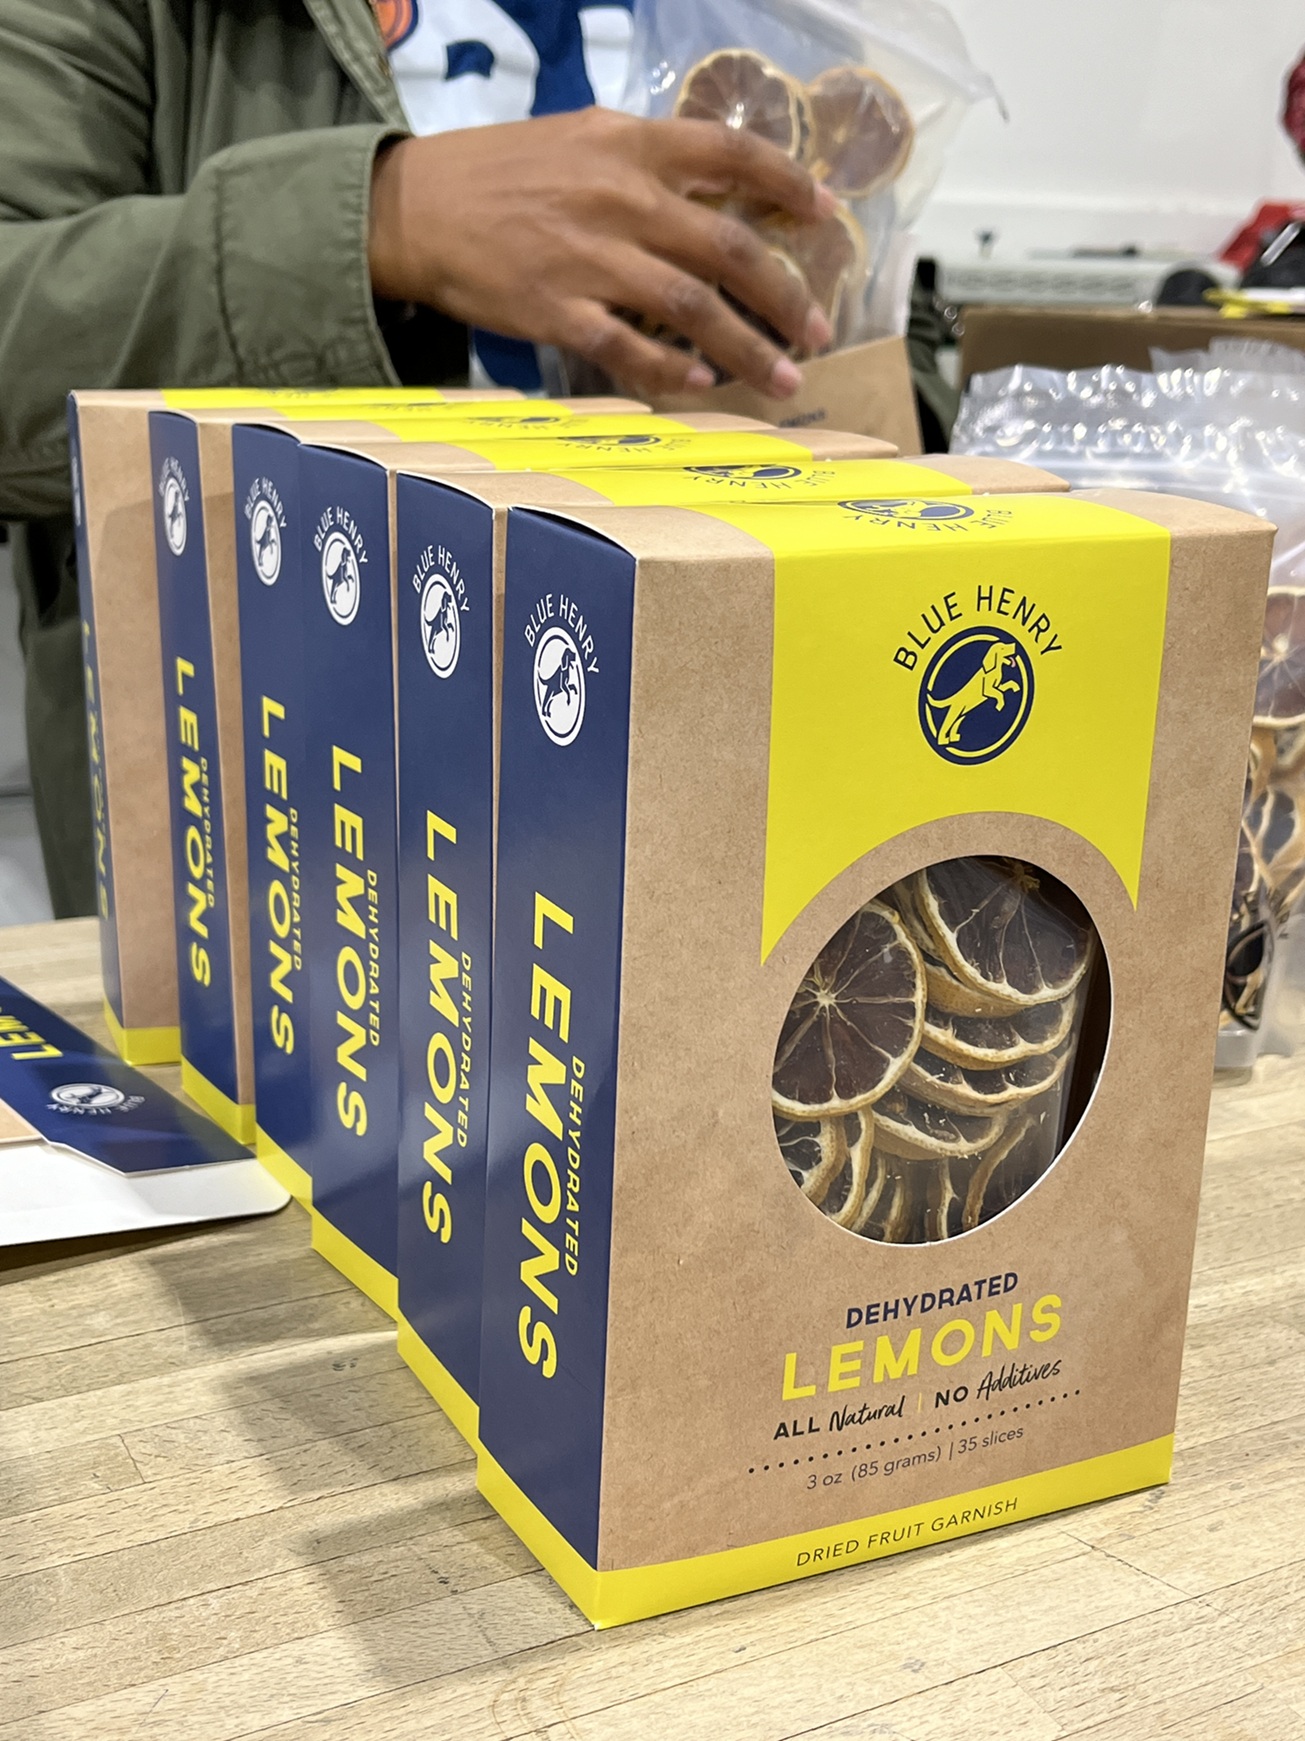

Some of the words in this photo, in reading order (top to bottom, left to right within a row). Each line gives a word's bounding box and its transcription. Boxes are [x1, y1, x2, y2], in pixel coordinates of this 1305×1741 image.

[261, 476, 287, 528] HENRY
[683, 474, 791, 490] HENRY
[799, 468, 836, 488] BLUE
[313, 506, 335, 552] BLUE
[336, 505, 369, 563] HENRY
[843, 513, 968, 532] HENRY
[968, 508, 1014, 530] BLUE
[412, 544, 435, 594] BLUE
[438, 545, 470, 612] HENRY
[524, 593, 555, 648] BLUE
[559, 594, 600, 673] HENRY
[893, 591, 963, 671] BLUE
[976, 584, 1063, 656] HENRY
[176, 655, 211, 989] LEMONS
[262, 694, 295, 1056] LEMONS
[289, 807, 302, 972] DEHYDRATED
[331, 744, 368, 1137] LEMONS
[367, 868, 381, 1047] DEHYDRATED
[0, 1005, 64, 1060] LEM
[422, 809, 458, 1243] LEMONS
[457, 950, 473, 1149] DEHYDRATED
[517, 892, 575, 1379] LEMONS
[565, 1053, 586, 1277] DEHYDRATED
[846, 1271, 1019, 1329] DEHYDRATED
[781, 1294, 1062, 1401] LEMONS
[773, 1416, 820, 1440] ALL
[828, 1395, 906, 1432] Natural
[934, 1386, 969, 1408] NO
[976, 1359, 1063, 1401] Additives
[806, 1474, 817, 1490] 3
[822, 1472, 842, 1487] oz
[851, 1462, 880, 1481] (85
[883, 1447, 942, 1476] grams)
[957, 1438, 978, 1454] 35
[981, 1426, 1024, 1448] slices
[796, 1538, 860, 1567] DRIED
[867, 1521, 924, 1549] FRUIT
[930, 1497, 1019, 1533] GARNISH
